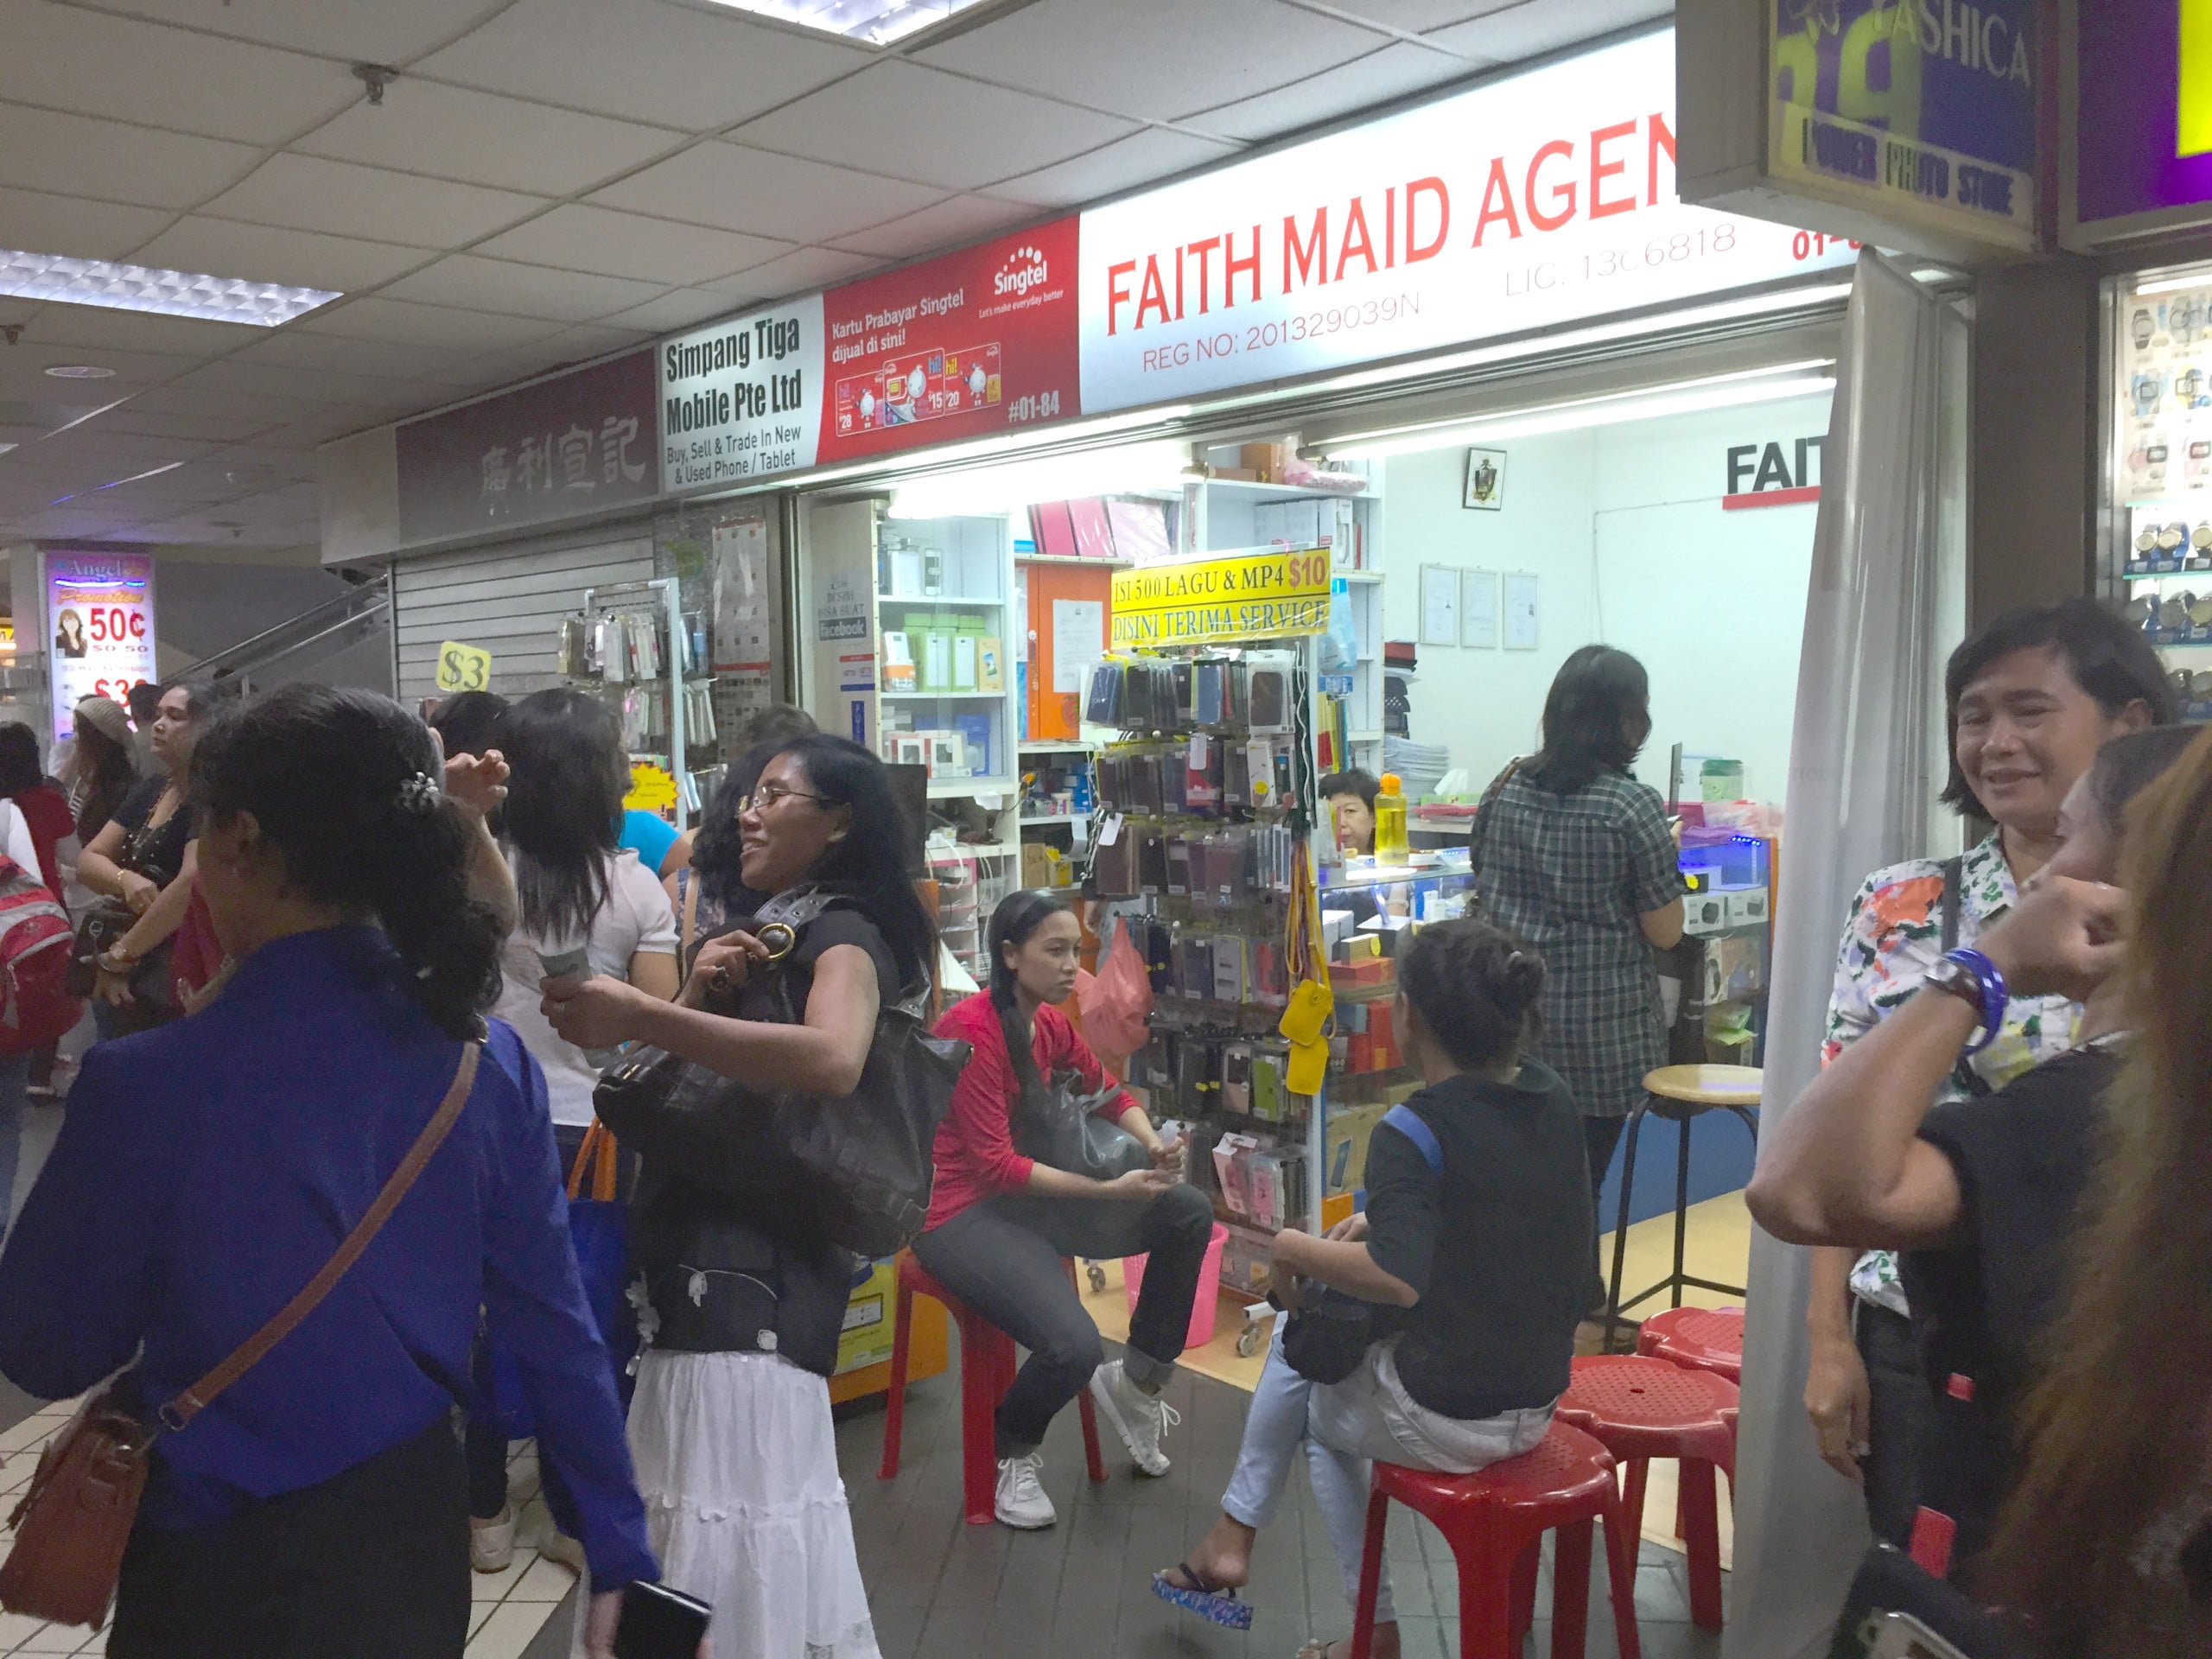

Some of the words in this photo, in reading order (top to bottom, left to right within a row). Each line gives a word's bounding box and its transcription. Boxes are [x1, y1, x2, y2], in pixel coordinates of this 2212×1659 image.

[1107, 224, 1262, 337] FAITH
[1282, 176, 1450, 296] MAID
[994, 259, 1047, 296] Singtel
[1506, 263, 1565, 296] LIC.
[832, 318, 863, 340] Kartu
[865, 303, 918, 332] Prabayar
[920, 289, 964, 317] Singtel
[979, 307, 993, 319] Let's
[994, 302, 1011, 315] make
[1013, 296, 1042, 311] everyday
[1043, 289, 1064, 302] better
[666, 331, 750, 382] Simpang
[754, 318, 800, 360] Tiga
[832, 338, 865, 364] dijual
[866, 337, 878, 355] di
[880, 329, 906, 350] sini!
[1143, 344, 1190, 372] REG
[1197, 334, 1239, 361] NO:
[1246, 291, 1420, 352] 201329039N
[666, 389, 729, 435] Mobile
[734, 382, 766, 421] Pte
[772, 369, 802, 415] Ltd
[928, 391, 943, 410] $15
[1008, 391, 1059, 423] #01-84
[667, 447, 689, 464] Buy,
[691, 440, 711, 460] Sell
[715, 437, 723, 455] &
[726, 432, 758, 451] Trade
[761, 429, 771, 448] In
[775, 425, 801, 443] New
[675, 467, 683, 485] &
[685, 462, 711, 483] Used
[715, 458, 748, 478] Phone
[760, 448, 796, 471] Tablet
[57, 587, 144, 605] Promotion
[1115, 580, 1131, 603] ISI
[1135, 576, 1161, 600] 500
[1166, 570, 1218, 597] LAGU
[1224, 569, 1236, 590] &
[1242, 564, 1284, 589] MP4
[1288, 556, 1326, 591] $10
[820, 620, 865, 639] facebook
[1114, 610, 1160, 642] DISINI
[1165, 607, 1233, 637] TERIMA
[1239, 601, 1326, 630] SERVICE
[442, 650, 484, 689] $3
[94, 677, 149, 708] $3
